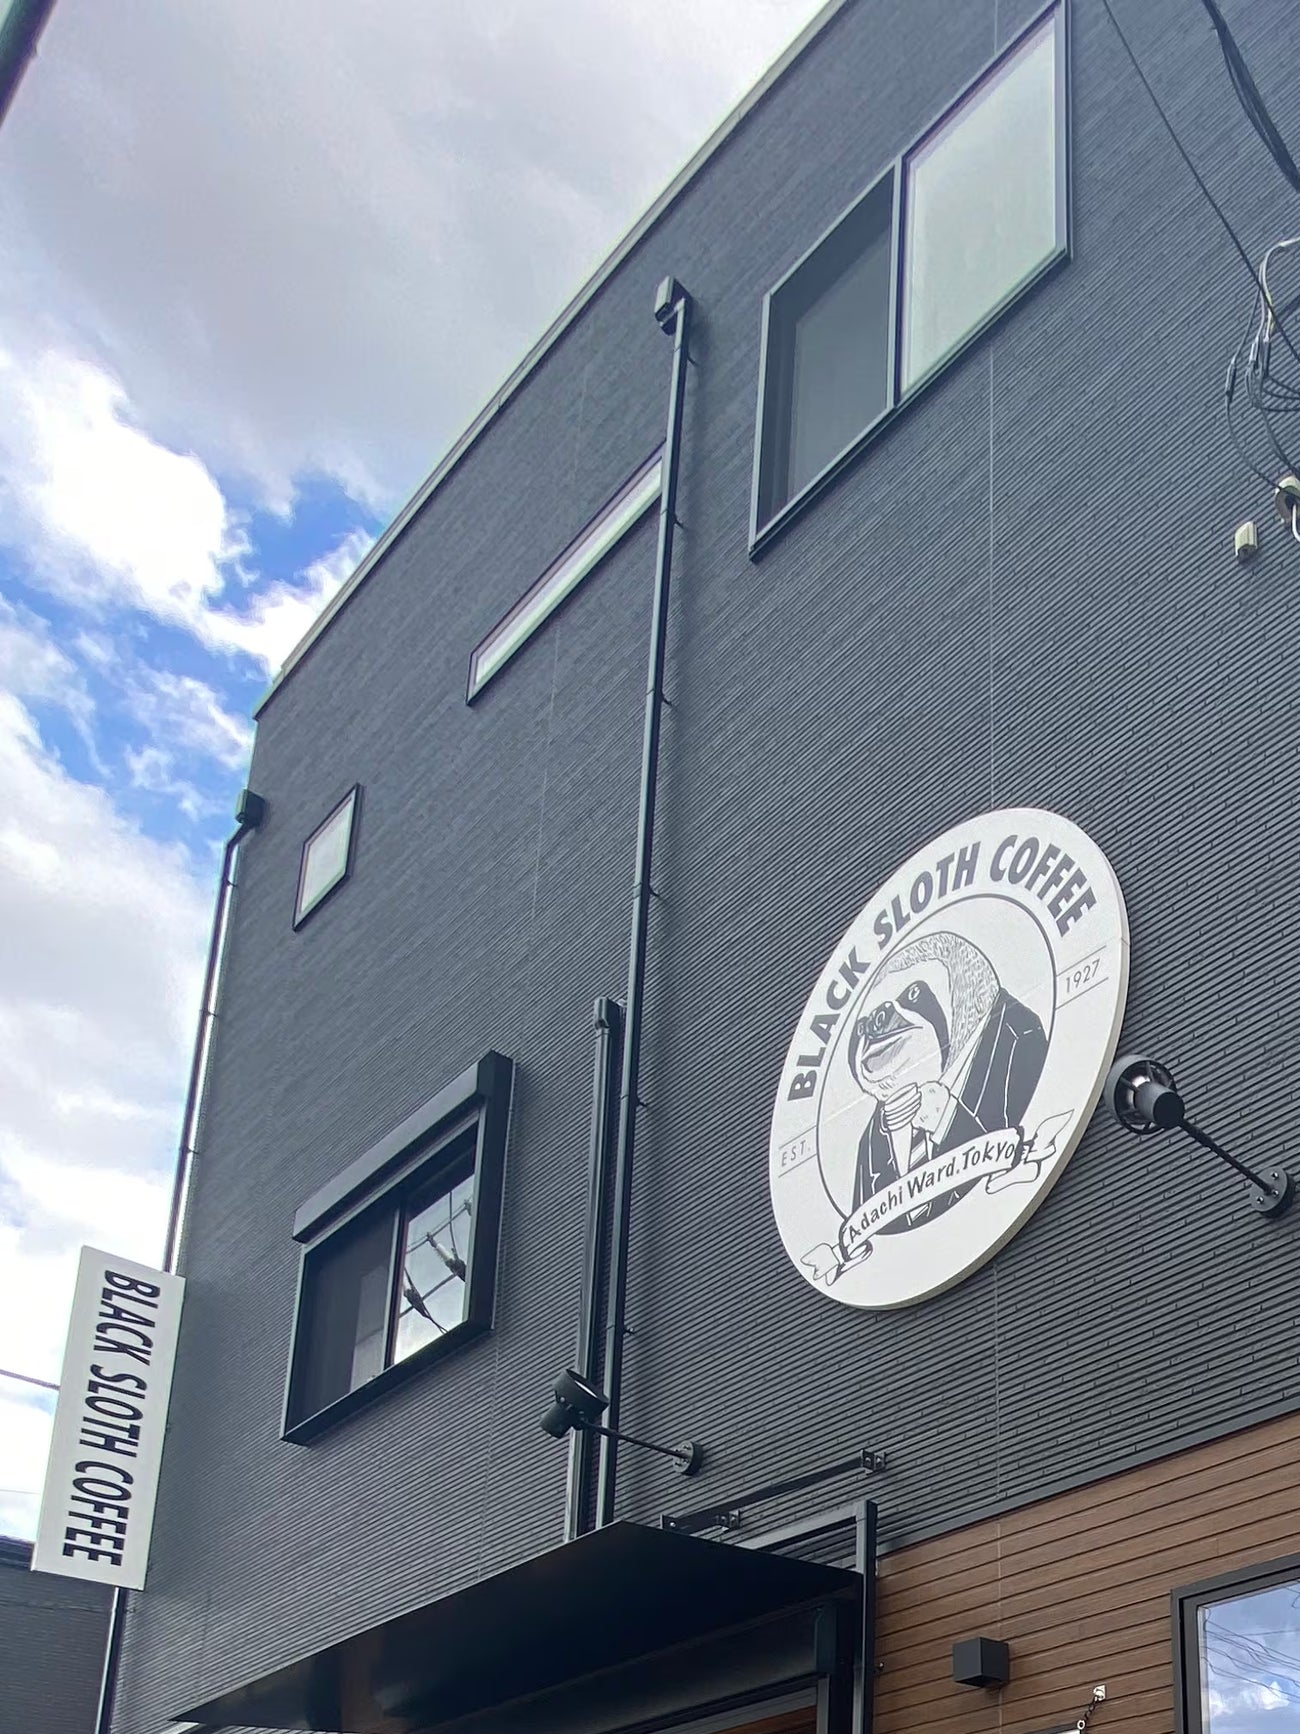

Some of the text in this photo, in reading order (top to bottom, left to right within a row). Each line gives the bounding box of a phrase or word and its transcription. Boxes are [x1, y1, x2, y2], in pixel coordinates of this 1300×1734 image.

[787, 833, 1097, 1102] BLACK SLOTH COFFEE
[1063, 959, 1101, 994] 1927
[848, 1186, 903, 1243] Adachi
[62, 1269, 161, 1567] BLACK SLOTH COFFEE
